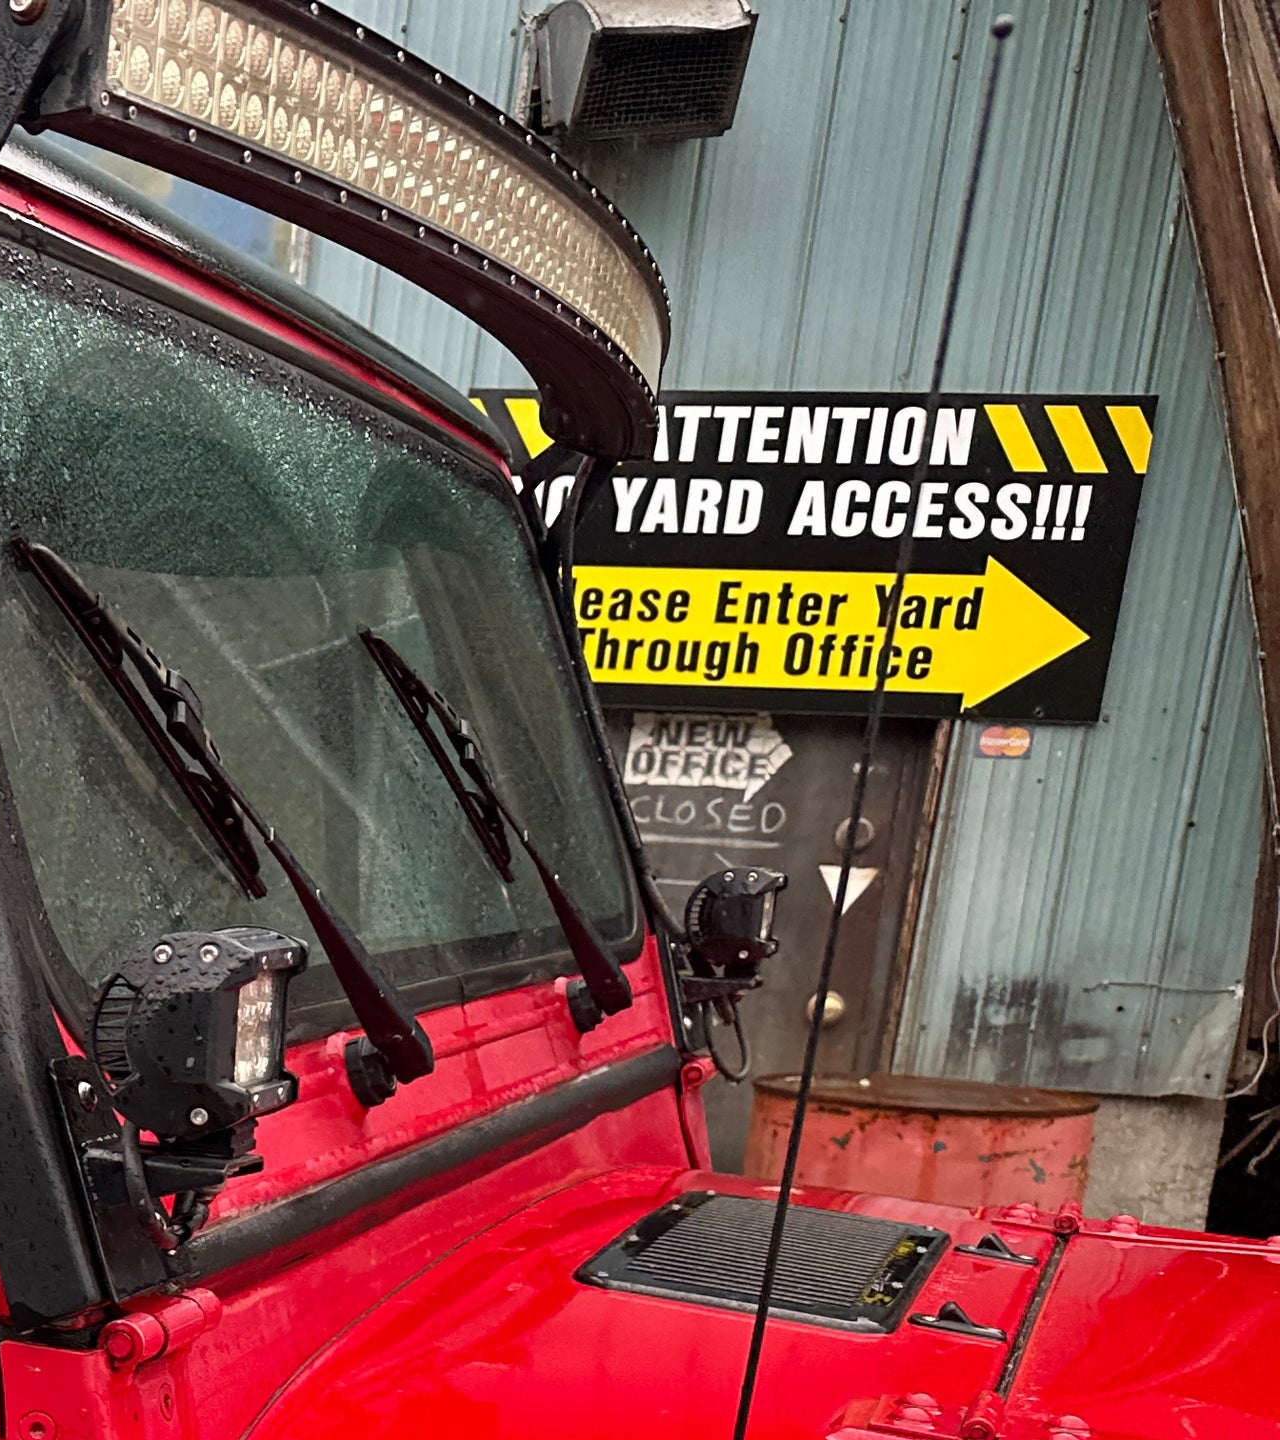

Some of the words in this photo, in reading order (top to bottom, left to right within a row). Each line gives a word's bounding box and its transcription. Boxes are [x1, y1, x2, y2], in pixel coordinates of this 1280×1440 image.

[612, 477, 764, 535] YARD
[787, 480, 1093, 541] ACCESS!!!
[714, 581, 848, 626] Enter
[875, 584, 984, 631] Yard
[783, 632, 933, 680] Office
[652, 719, 753, 748] NEW
[631, 745, 772, 779] OFFICE
[629, 795, 787, 835] CLOSED
